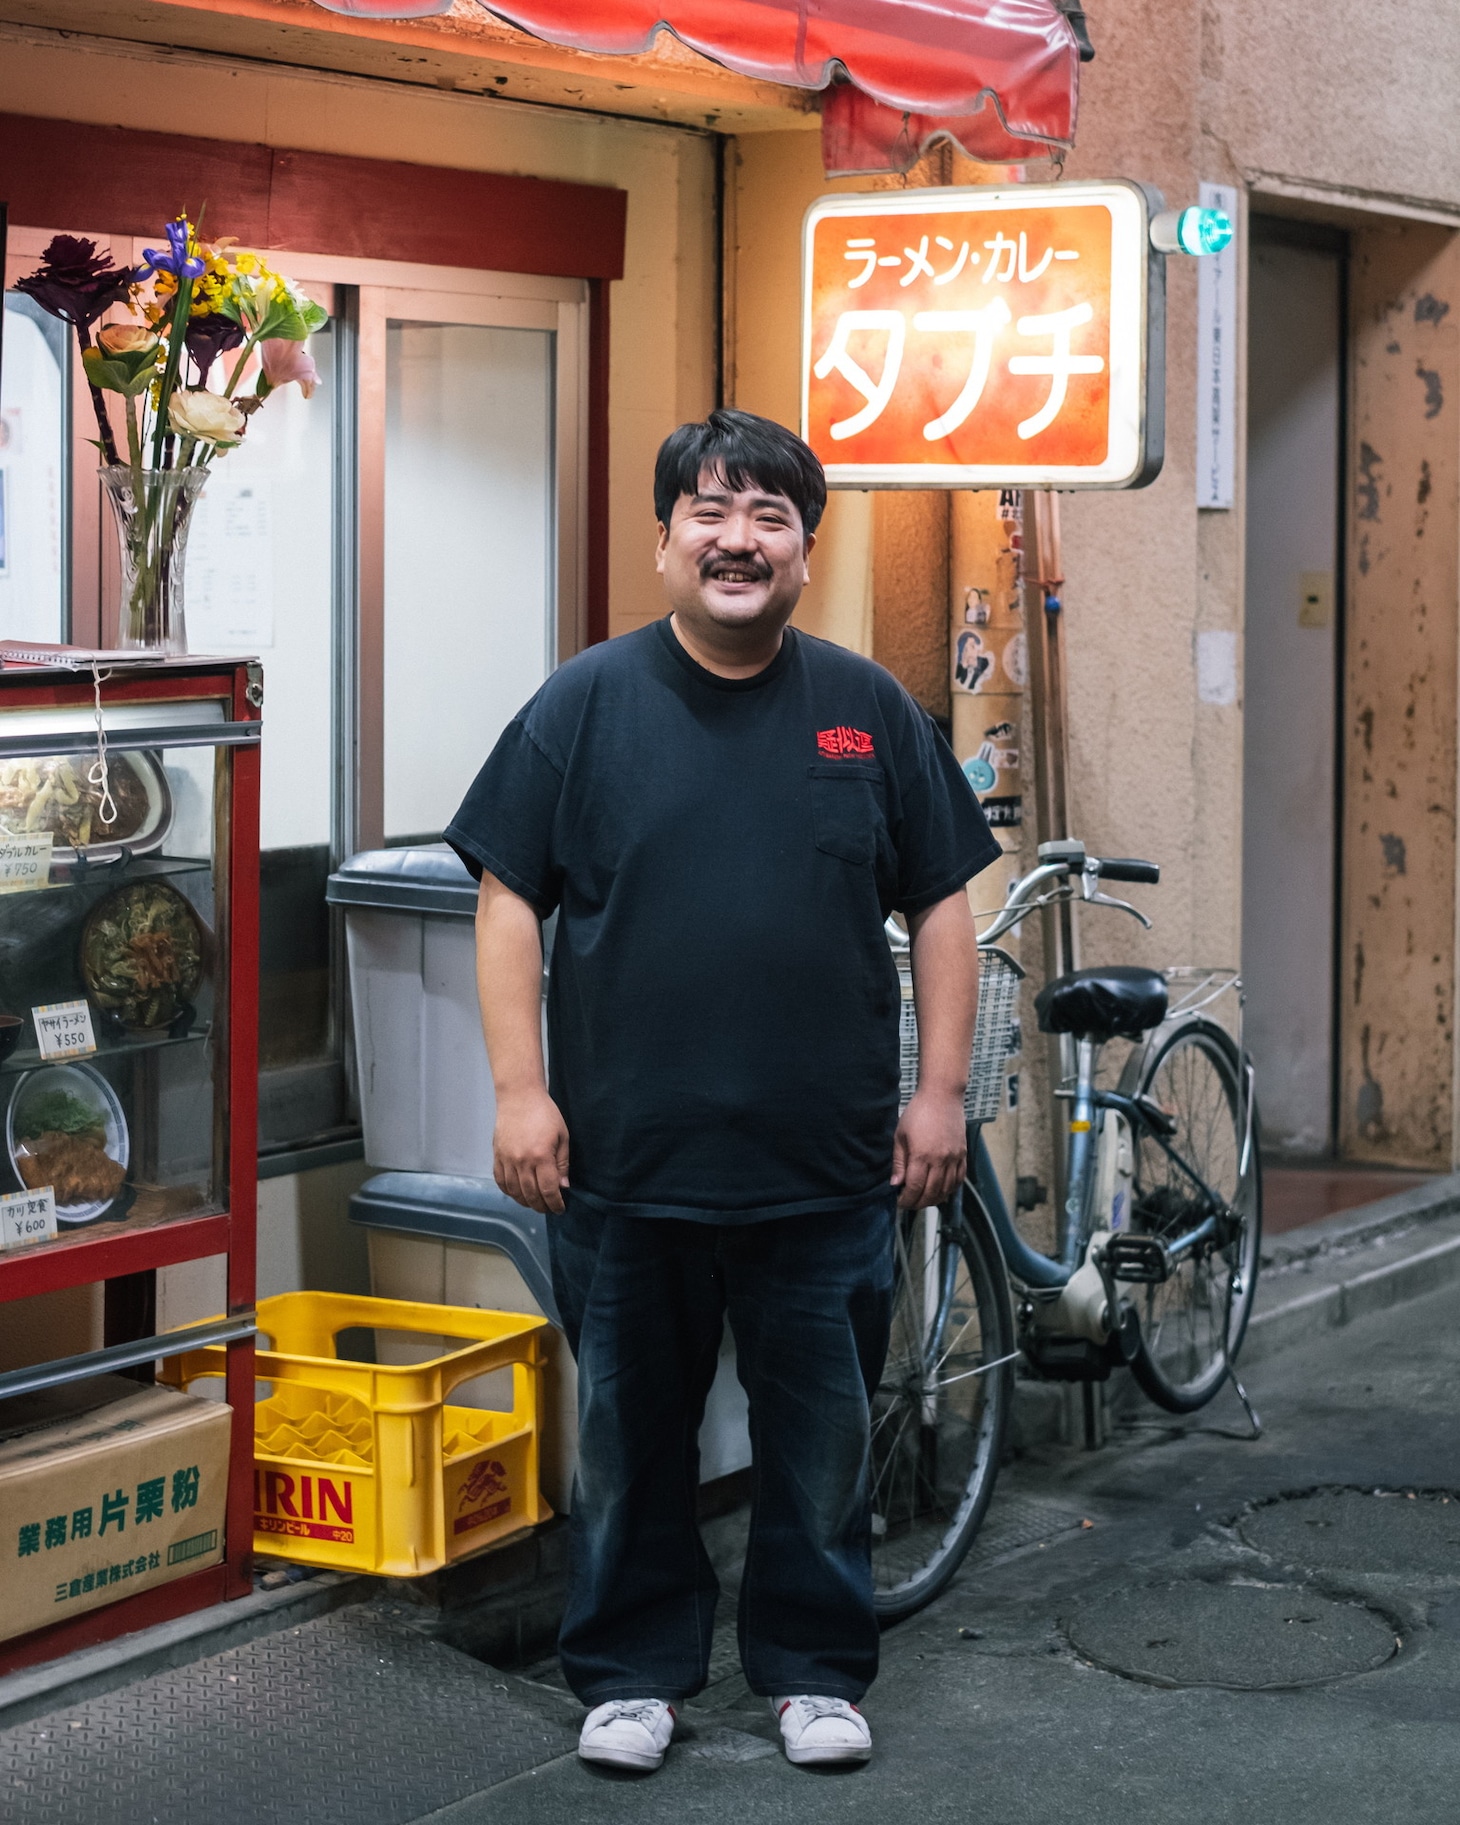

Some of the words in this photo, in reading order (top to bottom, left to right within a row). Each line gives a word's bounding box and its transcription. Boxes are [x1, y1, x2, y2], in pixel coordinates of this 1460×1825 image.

[844, 231, 1080, 289] ラーメン・カレー
[813, 296, 1104, 441] タブチ
[5, 862, 38, 877] ¥750
[54, 1032, 85, 1048] ¥550
[7, 1199, 48, 1218] カツ定食
[15, 1219, 46, 1237] ¥600
[254, 1469, 353, 1525] IRIN
[260, 1518, 311, 1536] キリンビール
